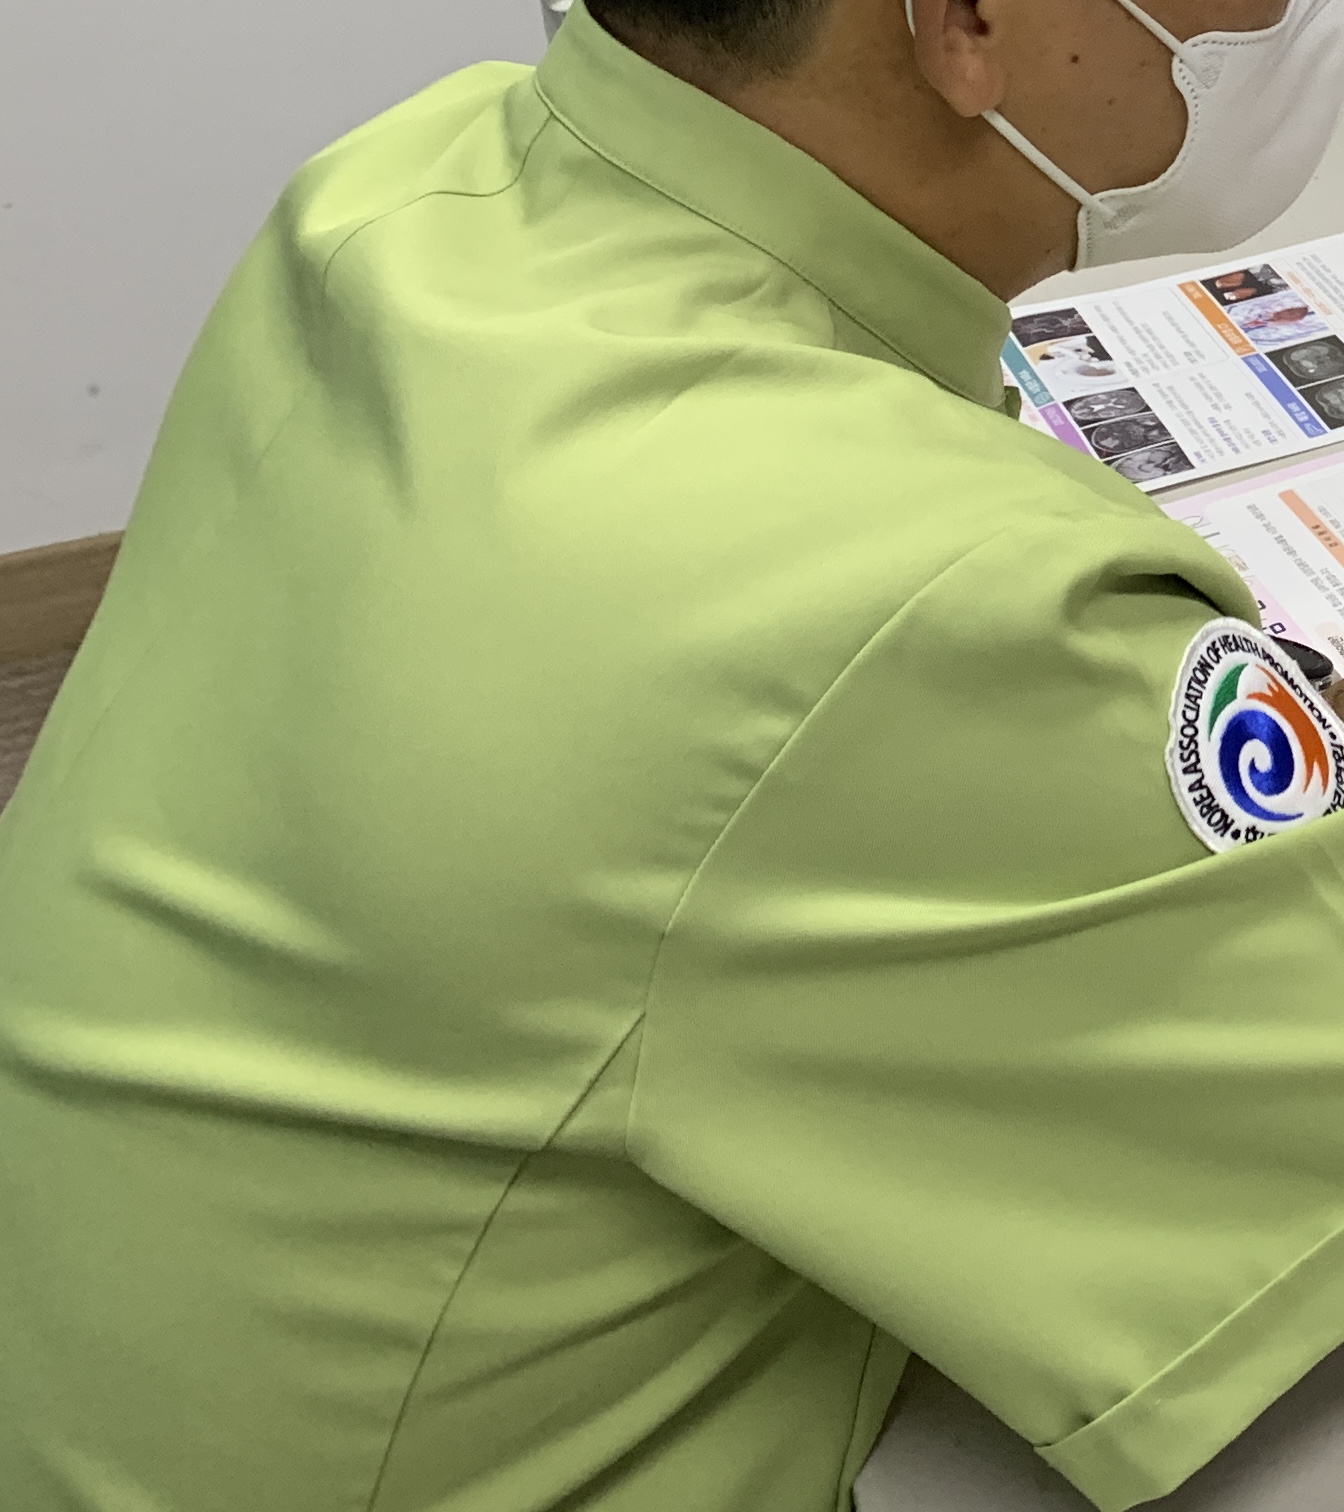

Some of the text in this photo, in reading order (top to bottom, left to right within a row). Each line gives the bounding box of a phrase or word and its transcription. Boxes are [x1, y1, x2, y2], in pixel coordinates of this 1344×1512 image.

[1179, 633, 1332, 839] KOREA ASSOCIATION OF HEALTH PROMOTION
